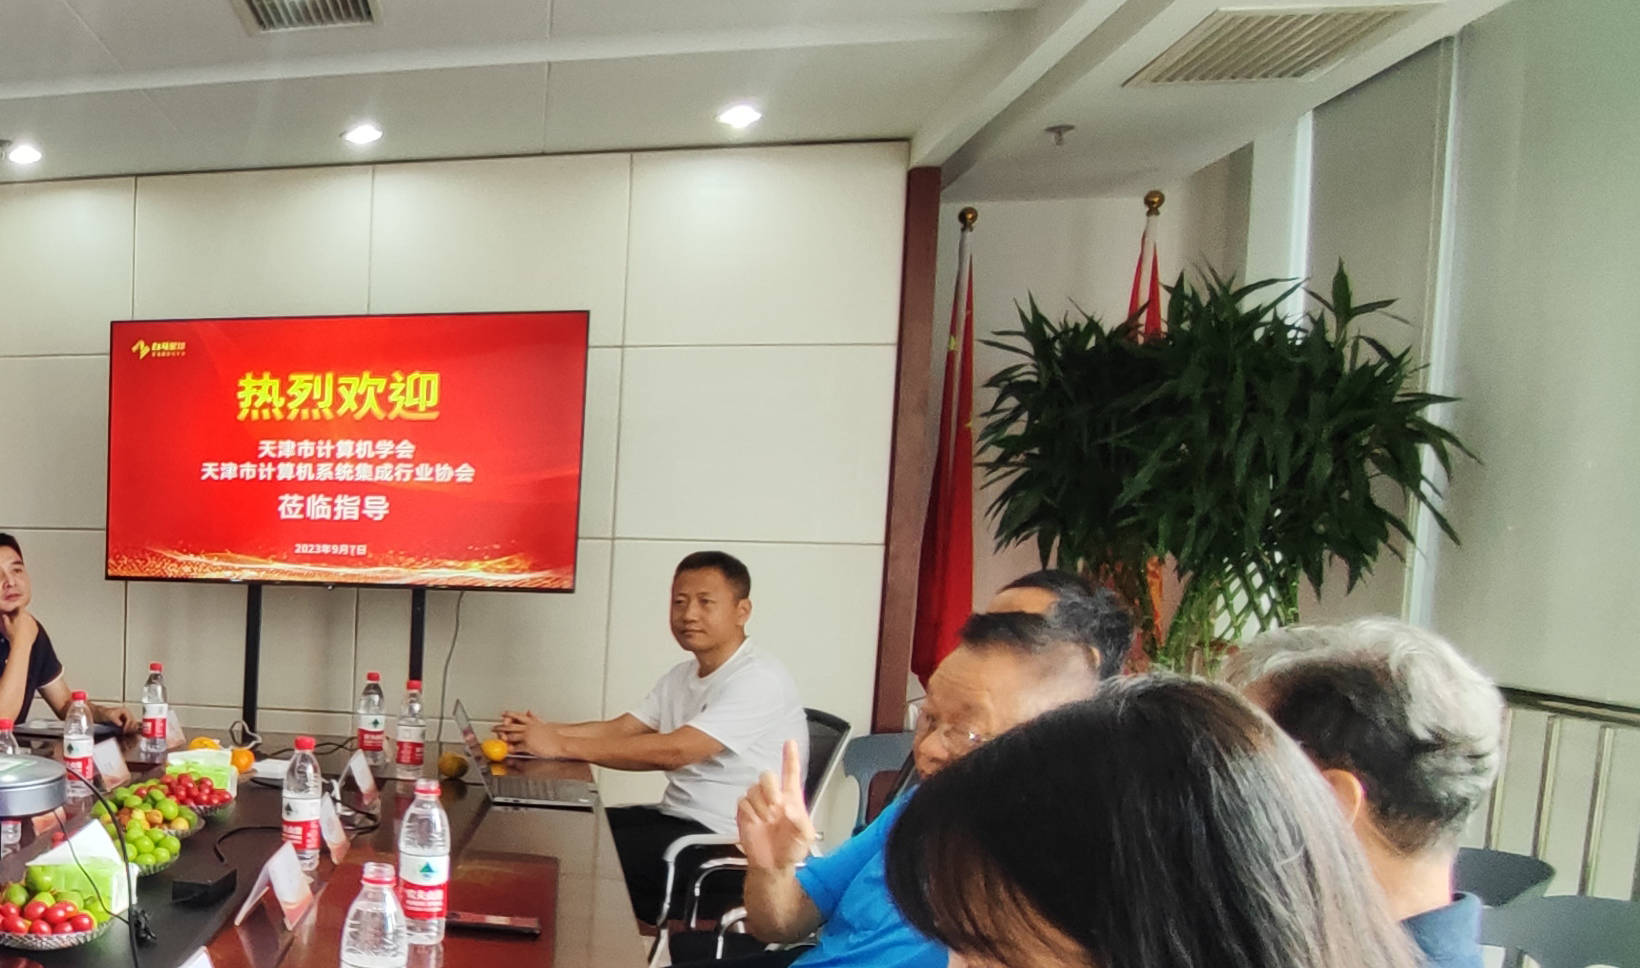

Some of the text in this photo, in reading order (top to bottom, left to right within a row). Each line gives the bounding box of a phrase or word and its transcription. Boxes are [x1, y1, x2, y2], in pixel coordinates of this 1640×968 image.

[236, 371, 440, 421] 热烈欢迎
[258, 439, 416, 459] 天津市计算机学会
[201, 462, 476, 483] 天津市计算机系统集成行业协会
[278, 494, 390, 521] 莅临指导
[293, 543, 368, 556] 2023年9月7日
